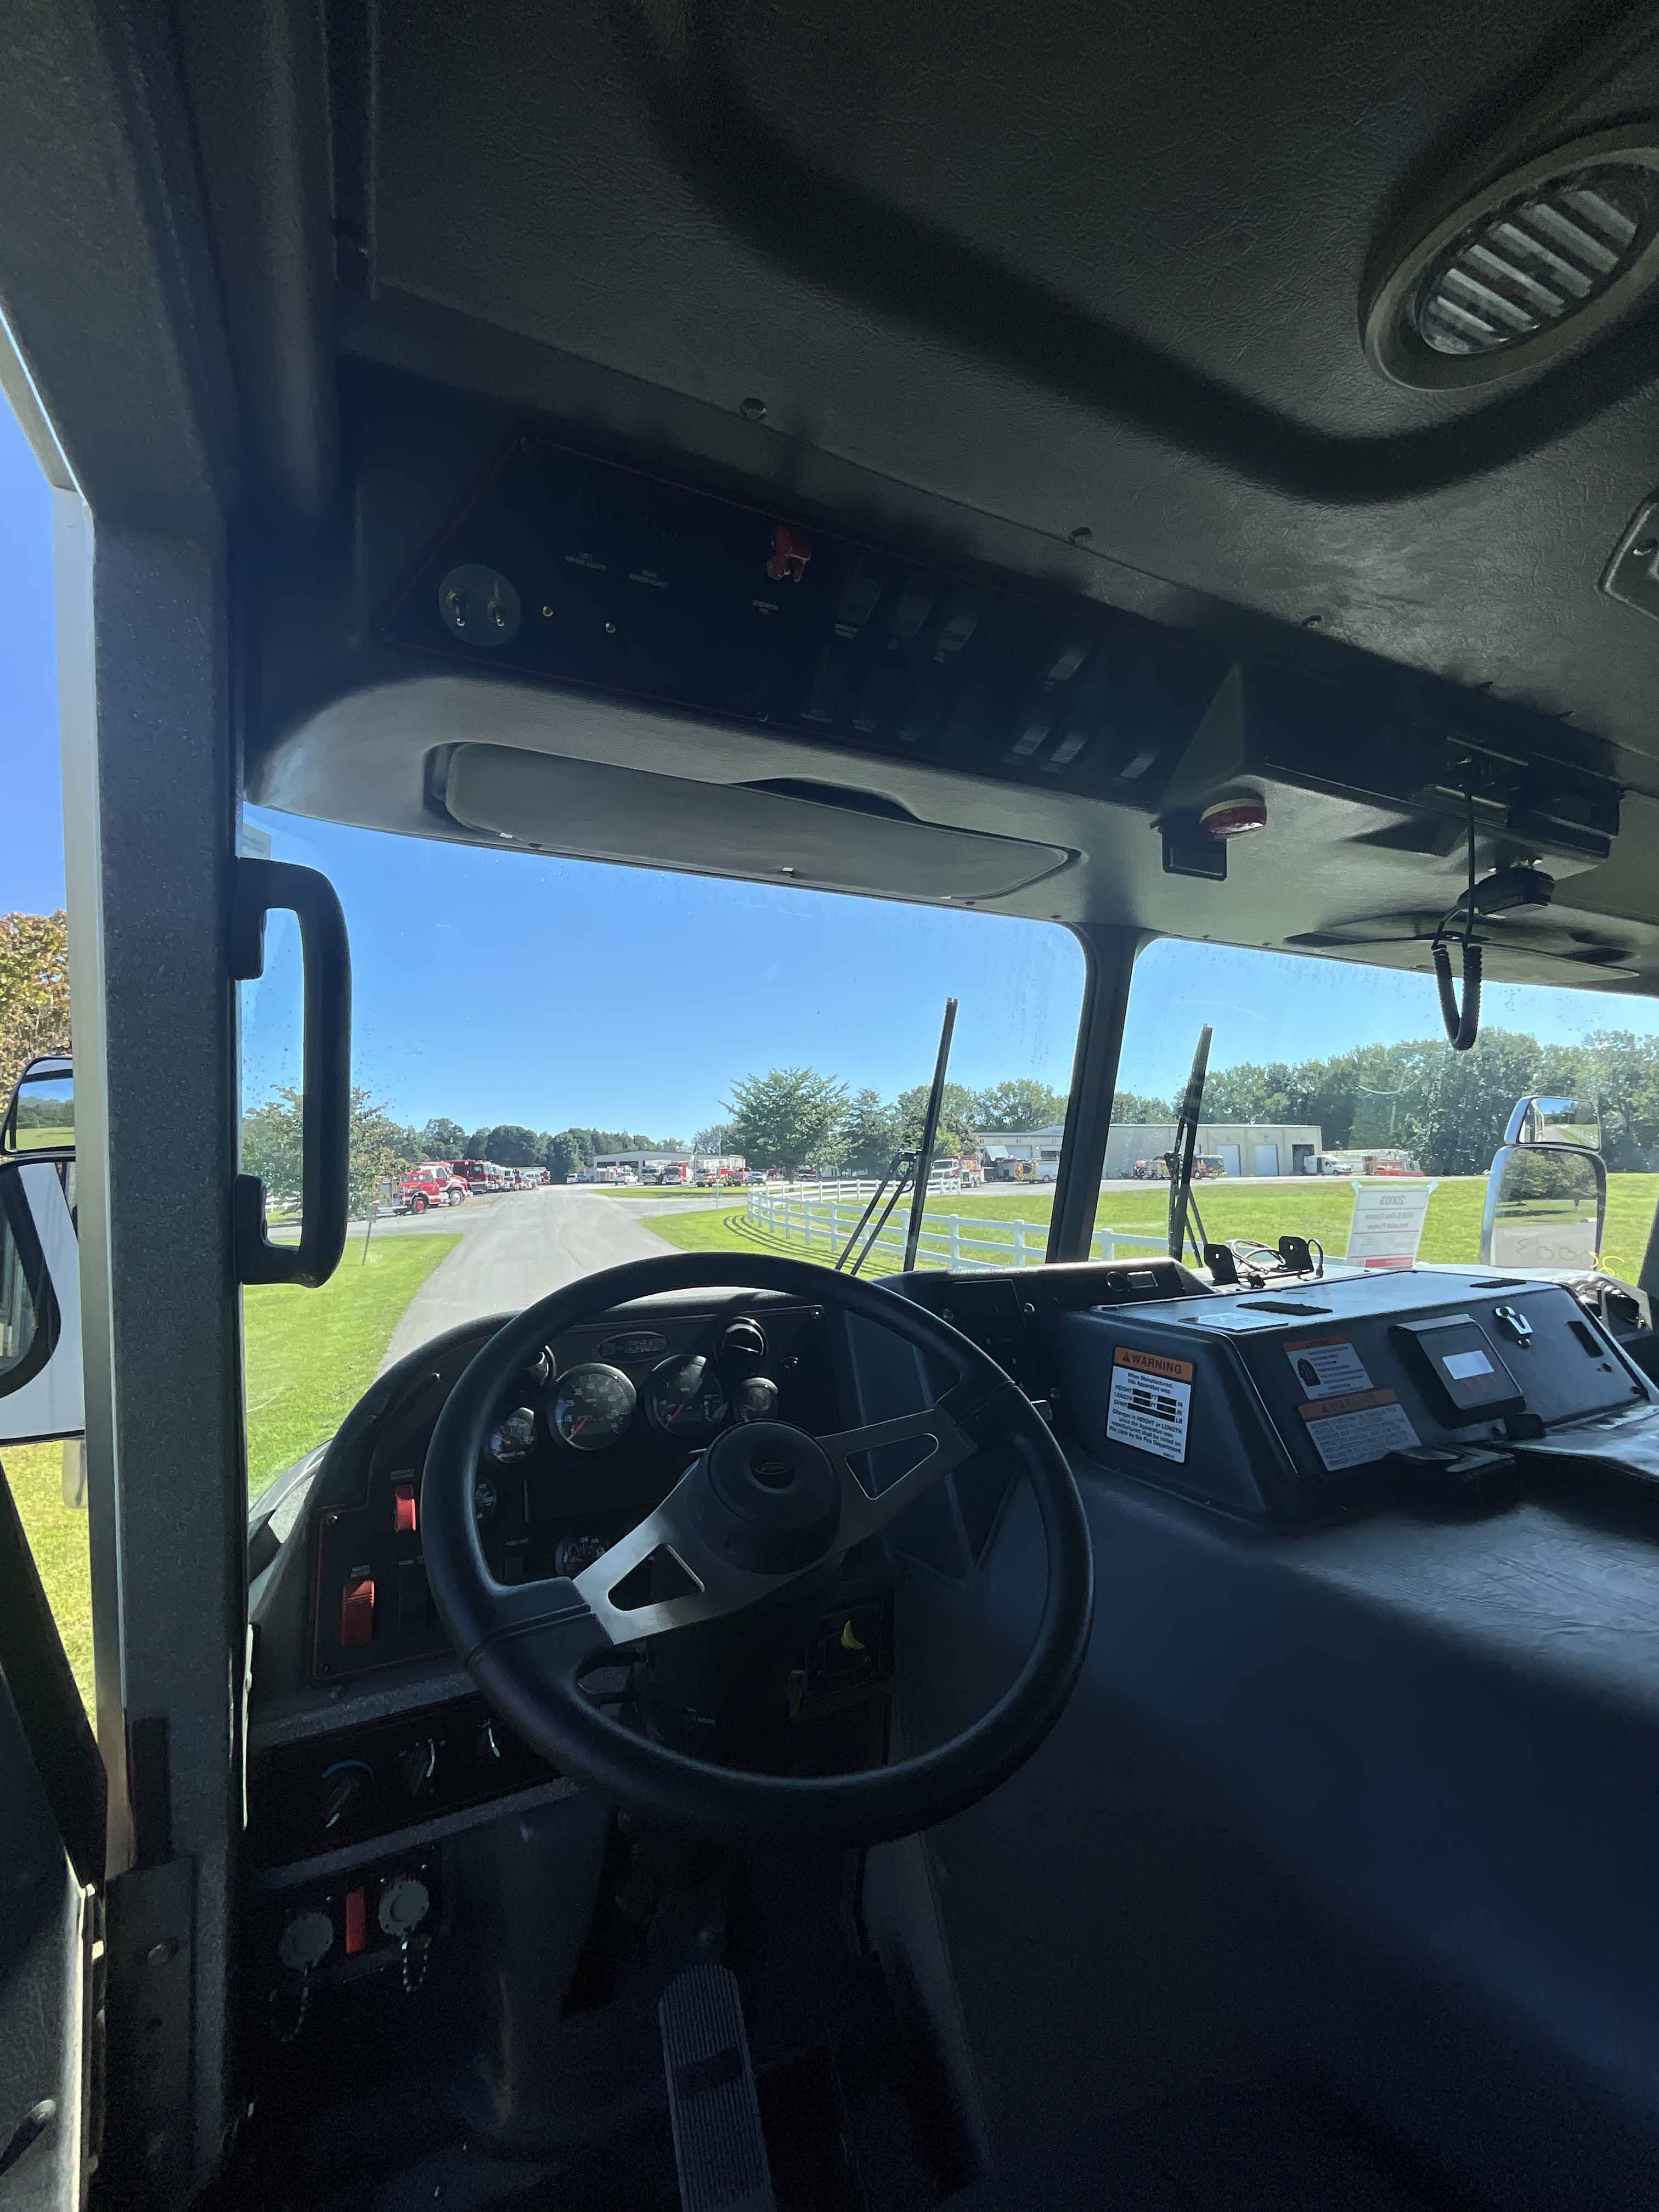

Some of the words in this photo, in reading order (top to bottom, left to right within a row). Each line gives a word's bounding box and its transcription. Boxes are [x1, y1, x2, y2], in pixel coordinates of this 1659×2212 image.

[1132, 1353, 1182, 1375] WARNING
[1115, 1384, 1132, 1393] HEIGHT
[1114, 1392, 1132, 1401] LENGTH
[1136, 1415, 1155, 1425] HEIGHT
[1161, 1423, 1182, 1434] LENGTH
[1139, 1422, 1163, 1434] Apparatus
[1128, 1430, 1135, 1438] by
[1143, 1435, 1152, 1444] Fire
